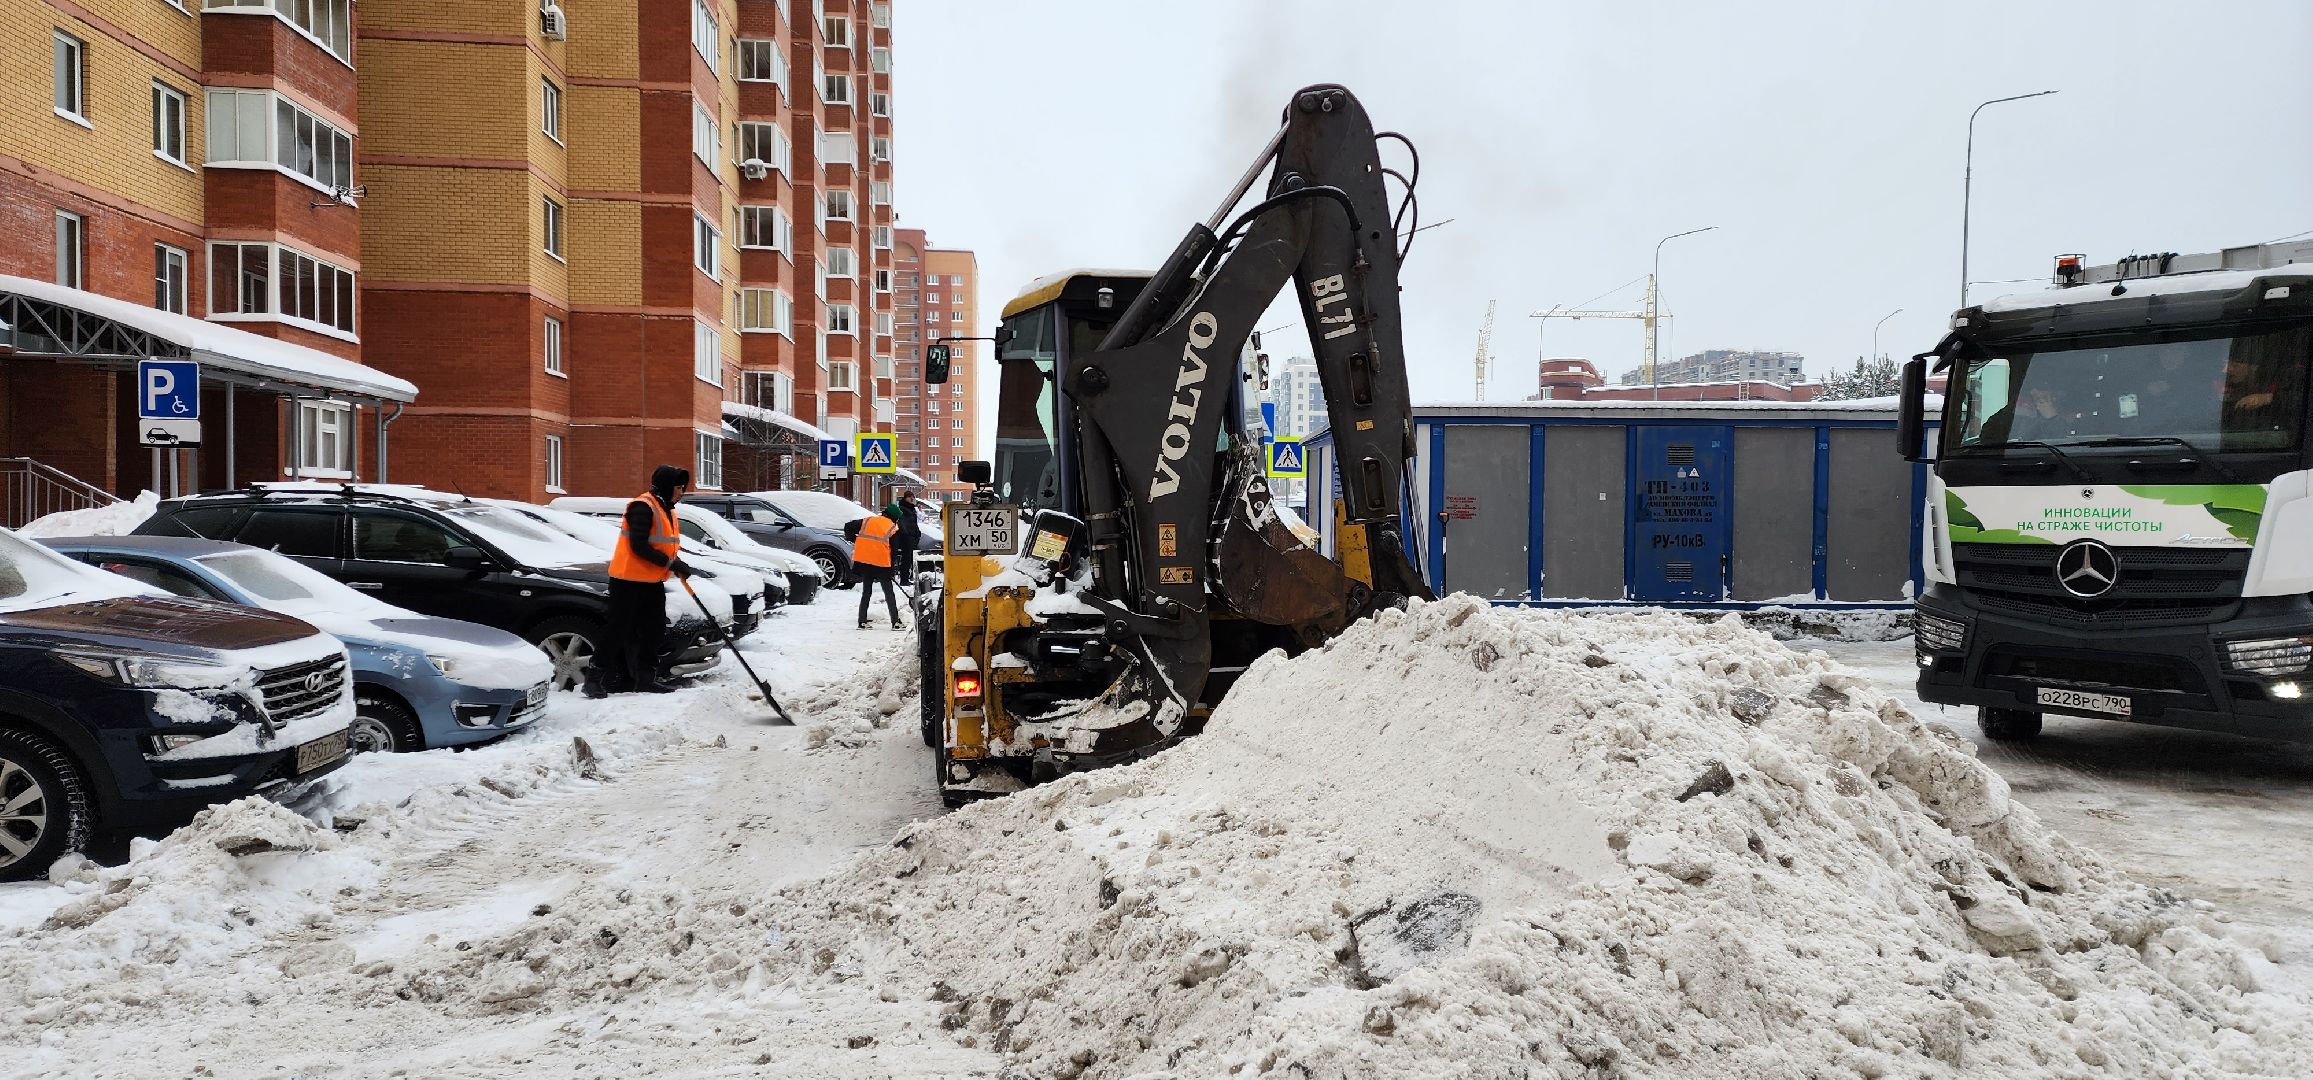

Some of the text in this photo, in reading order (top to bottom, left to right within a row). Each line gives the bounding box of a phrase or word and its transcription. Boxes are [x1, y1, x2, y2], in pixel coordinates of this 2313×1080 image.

[1310, 274, 1357, 340] BL71
[148, 368, 175, 411] P
[1147, 311, 1218, 503] VOLVO
[826, 443, 841, 464] P
[962, 511, 1005, 528] 1346
[2044, 507, 2132, 519] ИННОВАЦИИ
[2017, 521, 2162, 532] НА СТРАЖЕ ЧИСТОТЫ
[991, 530, 1008, 543] 50
[2104, 696, 2127, 709] 790
